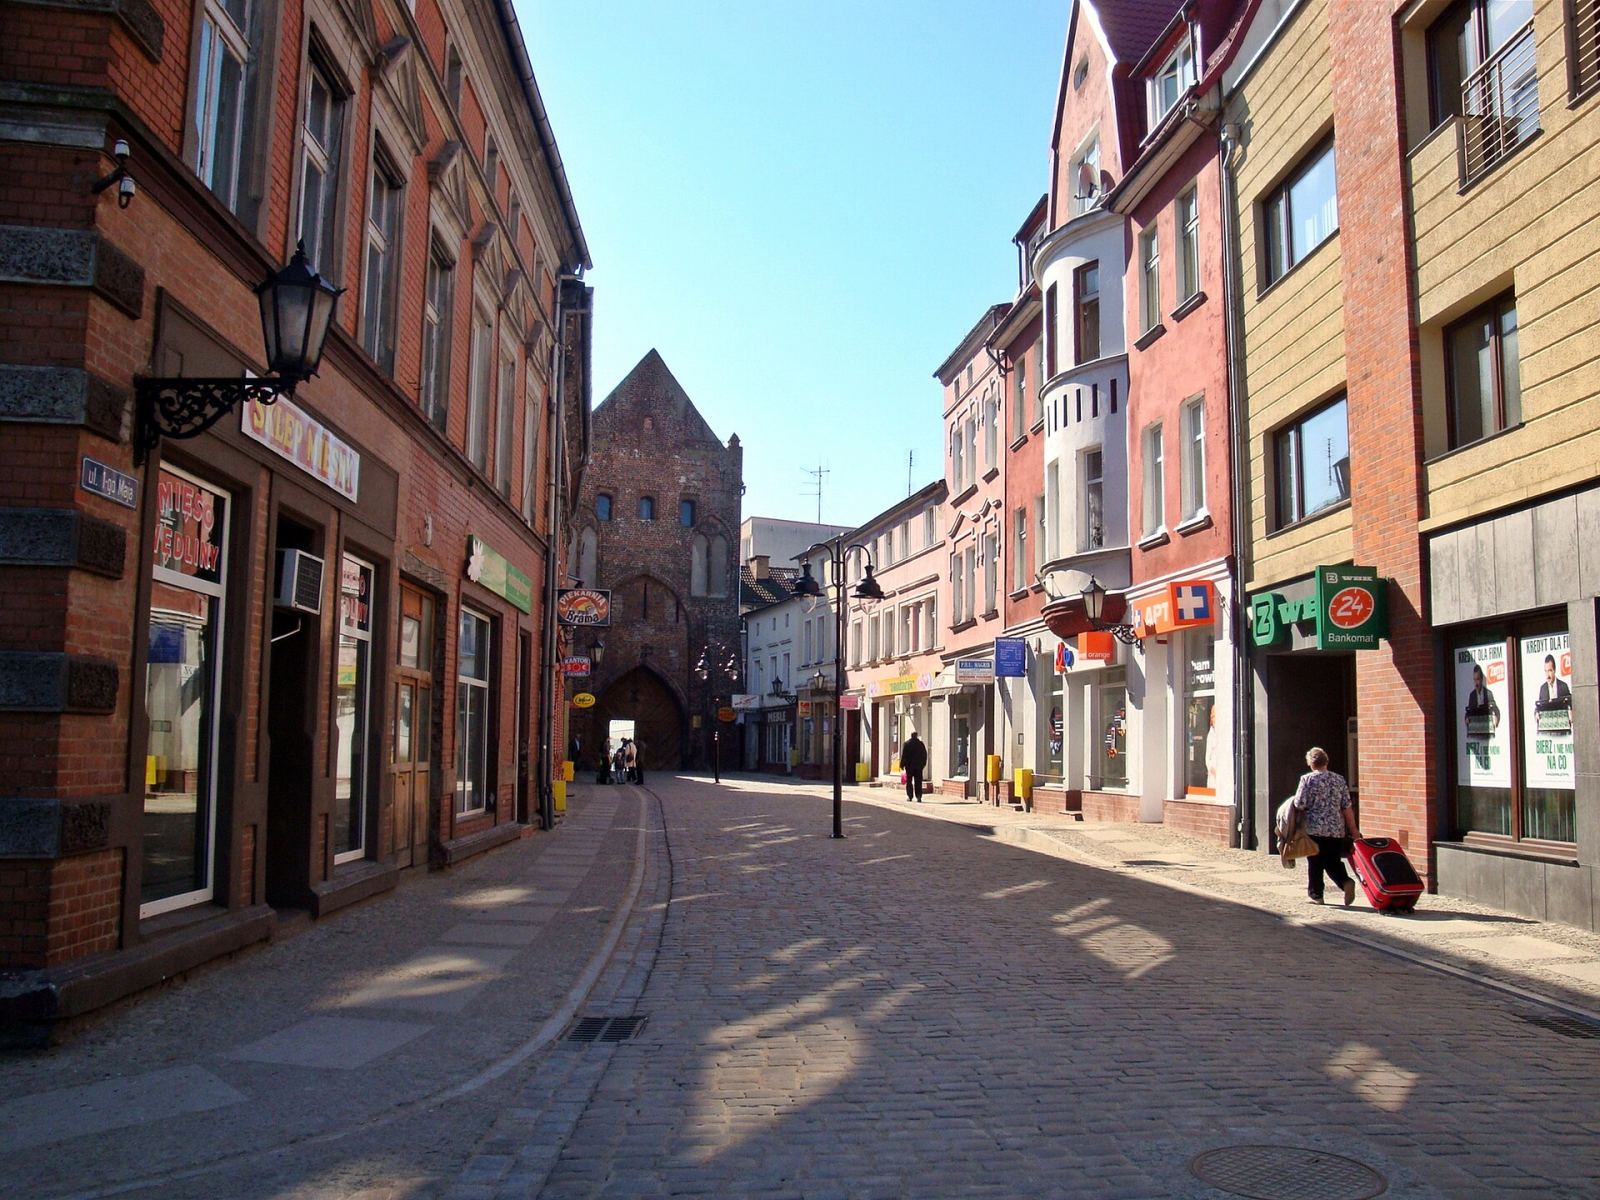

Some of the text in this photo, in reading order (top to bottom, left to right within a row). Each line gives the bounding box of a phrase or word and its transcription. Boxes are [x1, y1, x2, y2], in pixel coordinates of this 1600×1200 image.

[249, 398, 304, 454] SKLEP
[88, 467, 98, 486] ul.
[117, 478, 133, 503] Maja
[158, 481, 214, 530] MIĘSO
[559, 590, 607, 606] PIEKARNIA
[1336, 595, 1364, 617] 24
[567, 609, 599, 623] Brama
[1328, 632, 1374, 643] Bankomat
[1526, 637, 1548, 654] KREDYT
[1550, 636, 1562, 651] DLA
[1088, 652, 1111, 660] orange
[1489, 644, 1503, 660] FIRM
[1536, 739, 1553, 754] BIERZ
[1546, 754, 1567, 769] NA CO
